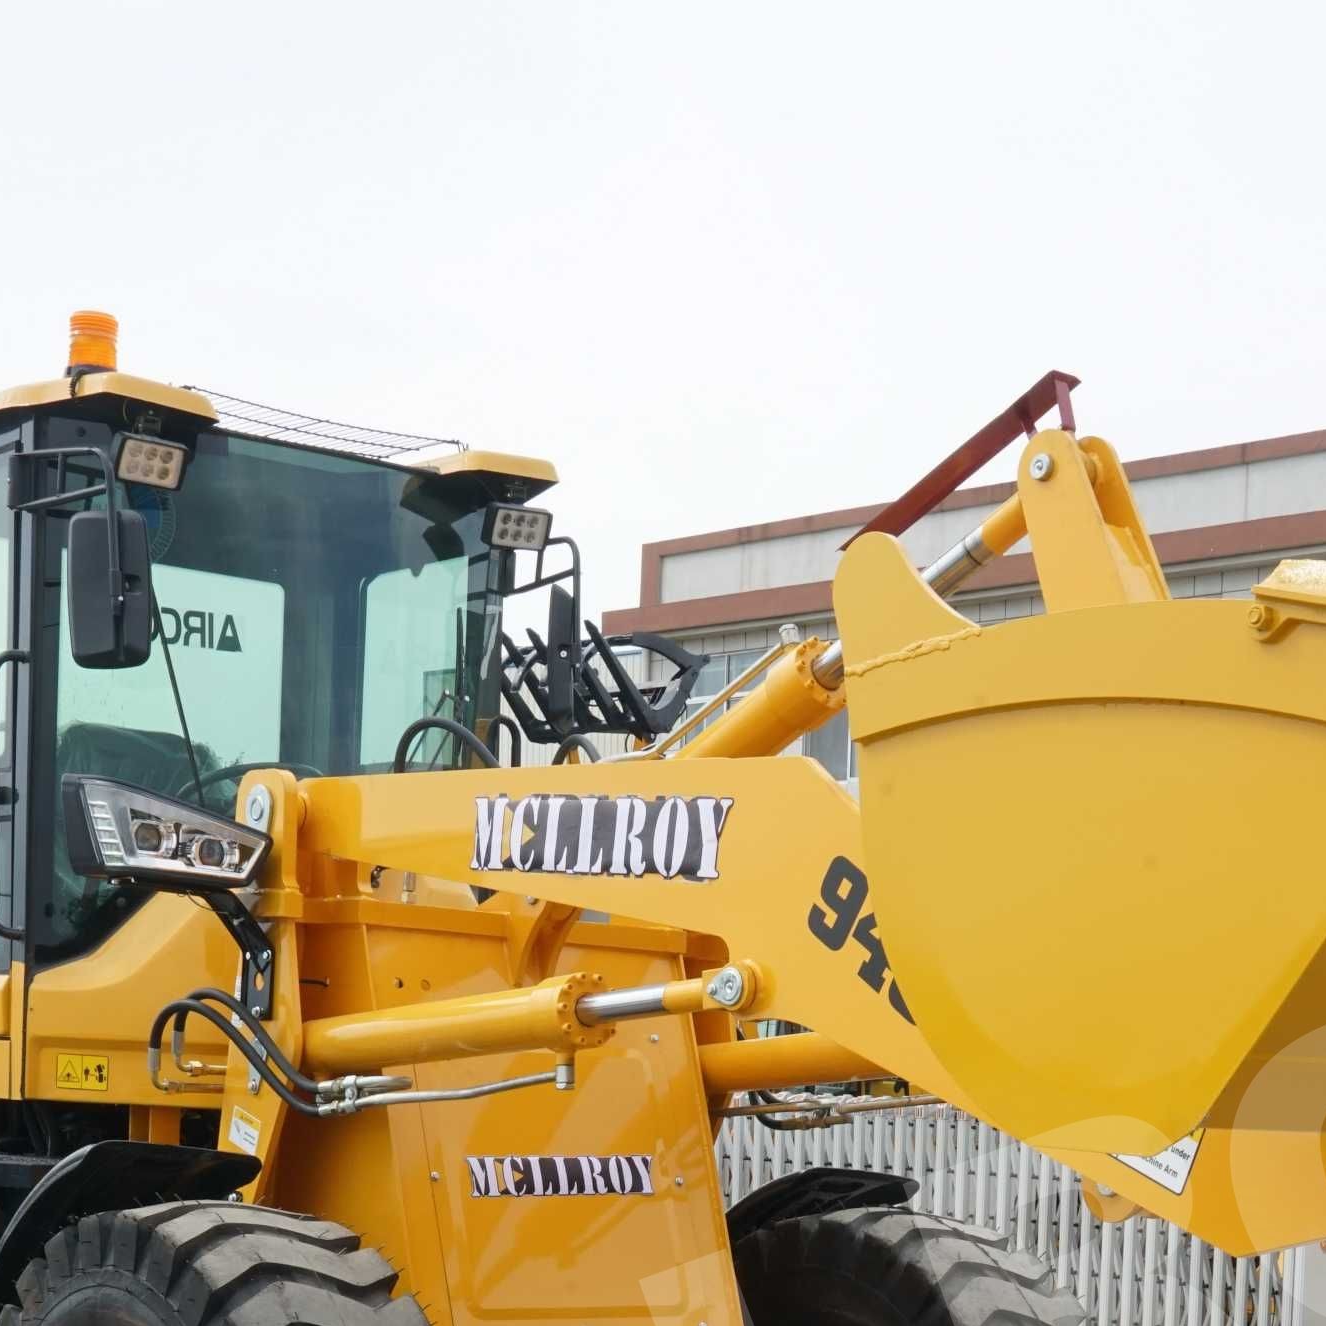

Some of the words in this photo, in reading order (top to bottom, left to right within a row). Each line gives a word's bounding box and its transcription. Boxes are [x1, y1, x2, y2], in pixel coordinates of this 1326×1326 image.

[470, 797, 733, 878] MCLLROY
[467, 1155, 654, 1197] MCLLROY
[1164, 1164, 1178, 1178] Arm
